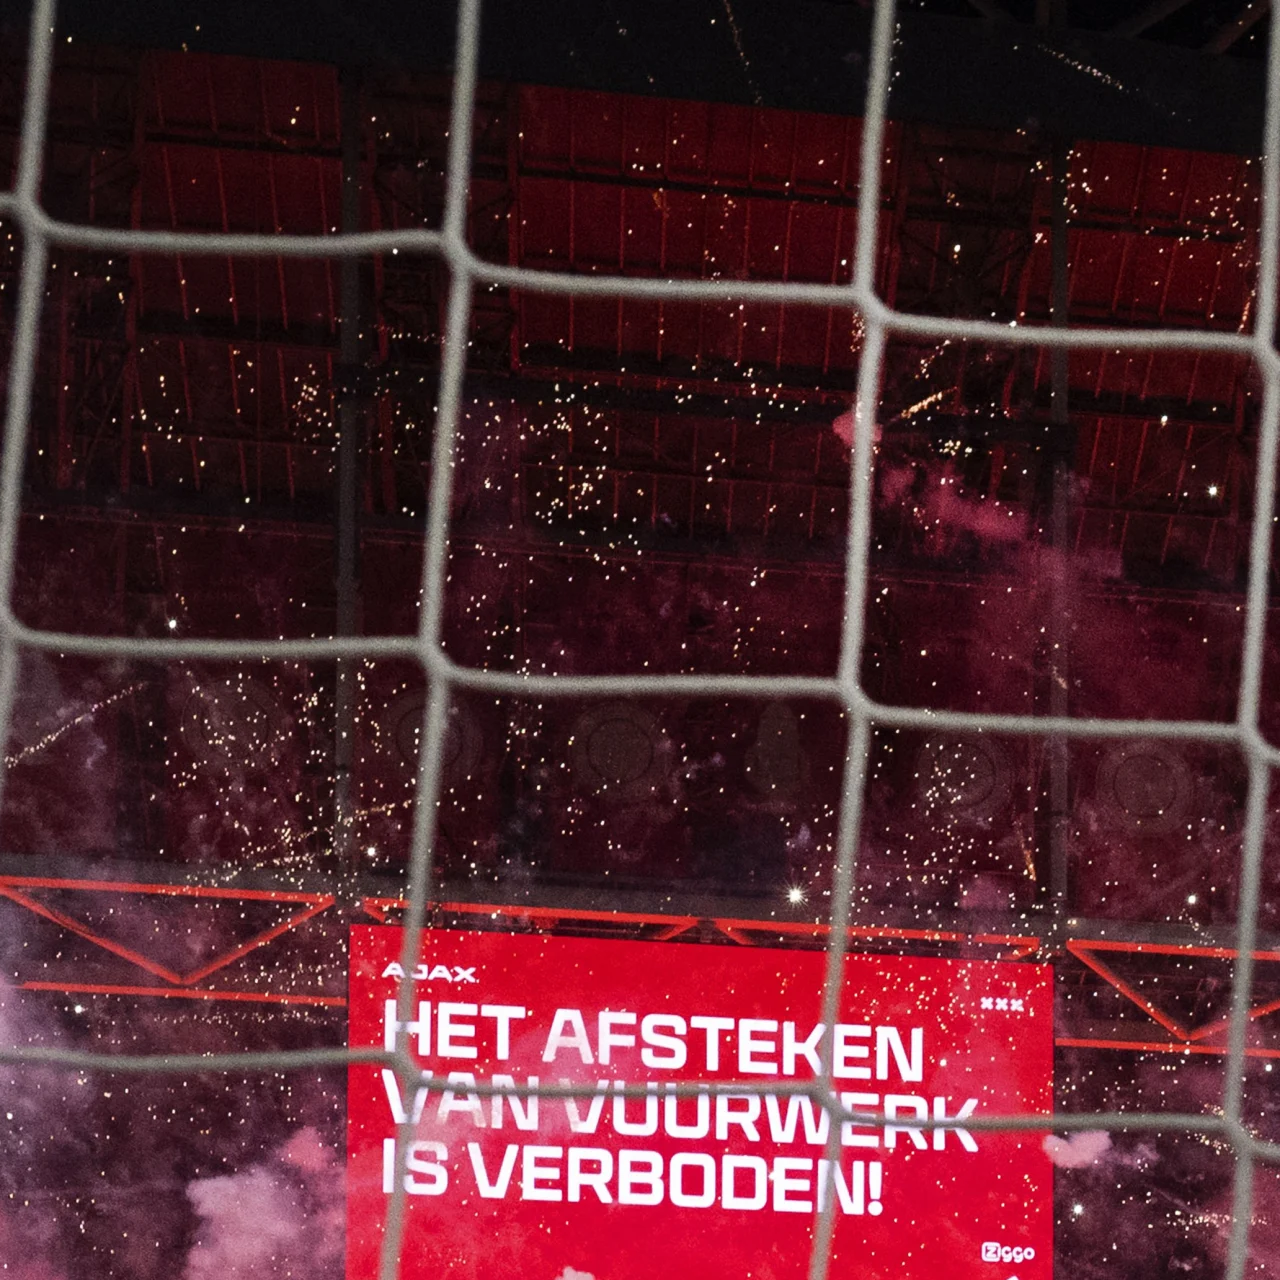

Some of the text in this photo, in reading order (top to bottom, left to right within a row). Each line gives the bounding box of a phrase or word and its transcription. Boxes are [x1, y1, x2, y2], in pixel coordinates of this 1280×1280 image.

[381, 962, 477, 982] AJAX
[384, 999, 924, 1082] HET AFSTEKEN
[381, 1068, 979, 1152] VAN VUURWERK
[382, 1138, 883, 1216] IS VERBODEN!
